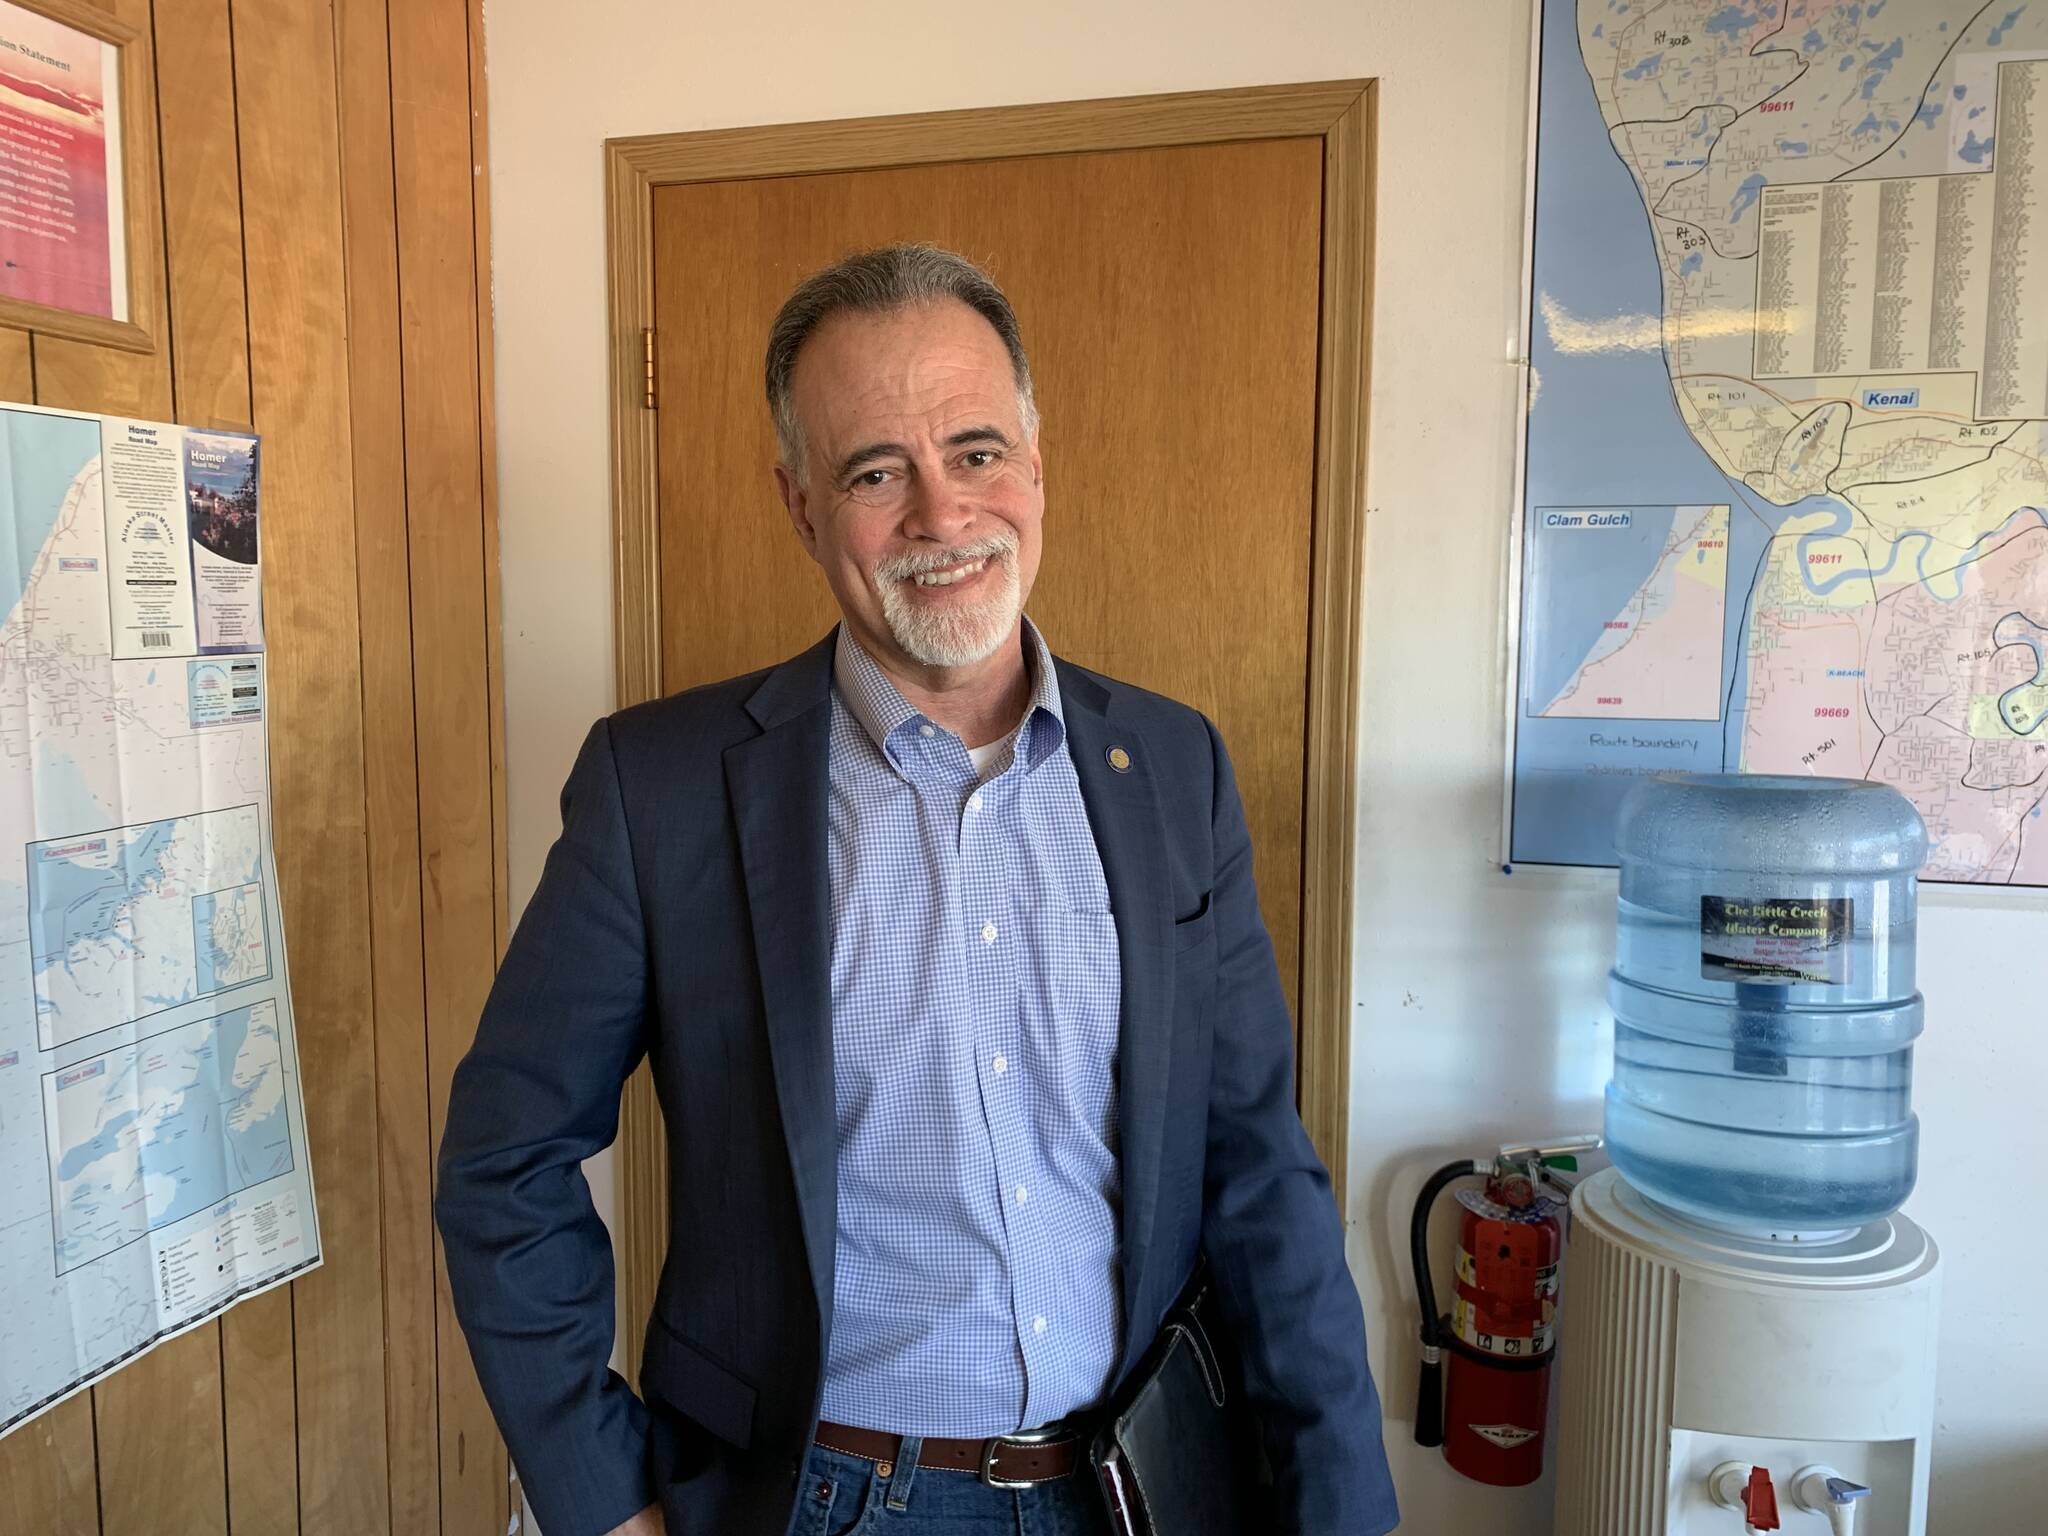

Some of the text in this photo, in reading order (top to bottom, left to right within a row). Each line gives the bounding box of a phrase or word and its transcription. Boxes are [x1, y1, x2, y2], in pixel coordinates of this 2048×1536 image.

[19, 44, 71, 72] Statement
[1759, 101, 1795, 113] 99611
[1868, 391, 1915, 406] Kenai
[128, 425, 157, 437] Homer
[128, 436, 158, 446] Road Map
[191, 449, 227, 463] Homer
[1546, 512, 1630, 526] Clam Gulch
[1808, 553, 1843, 565] 99611
[1828, 668, 1864, 678] K-BEACH
[1813, 707, 1850, 718] 99669
[1590, 733, 1698, 752] Route boundary
[87, 842, 103, 851] Bay
[1724, 904, 1828, 919] The Little Creek
[1725, 922, 1828, 938] Water Company
